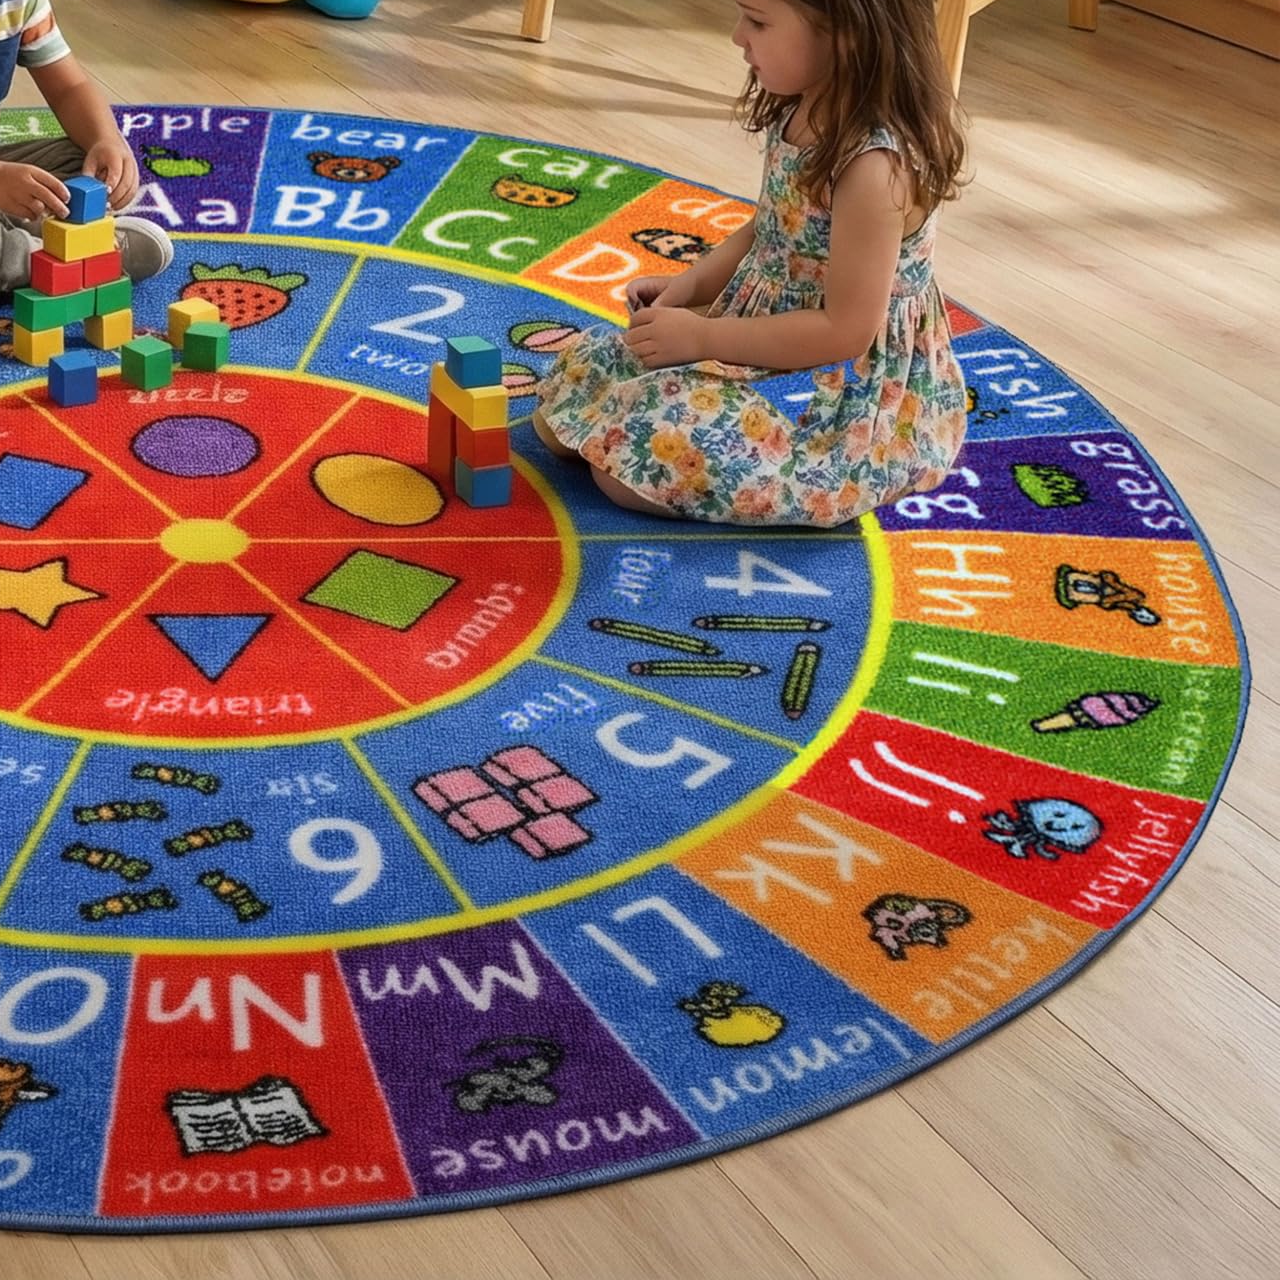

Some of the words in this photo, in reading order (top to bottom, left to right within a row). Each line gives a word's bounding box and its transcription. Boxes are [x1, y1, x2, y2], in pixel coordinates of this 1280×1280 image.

[122, 111, 250, 139] pple
[291, 114, 448, 152] bear
[125, 181, 241, 228] Aa
[497, 148, 628, 189] cat
[272, 186, 390, 232] Bb
[422, 209, 540, 261] Cc
[369, 284, 465, 344] 2
[954, 346, 1075, 419] fish
[1070, 439, 1185, 532] grass
[704, 550, 832, 596] 4
[911, 542, 1012, 619] Hh
[104, 689, 317, 721] triangle
[595, 714, 734, 790] 5
[849, 742, 985, 823] Jj
[289, 816, 383, 906] 6
[713, 813, 883, 905] Kk
[358, 940, 542, 1011] Mm
[583, 895, 725, 988] Ll
[147, 973, 326, 1052] Nn
[688, 1016, 912, 1114] lemon
[431, 1104, 673, 1178] mouse
[124, 1164, 386, 1203] notebook
